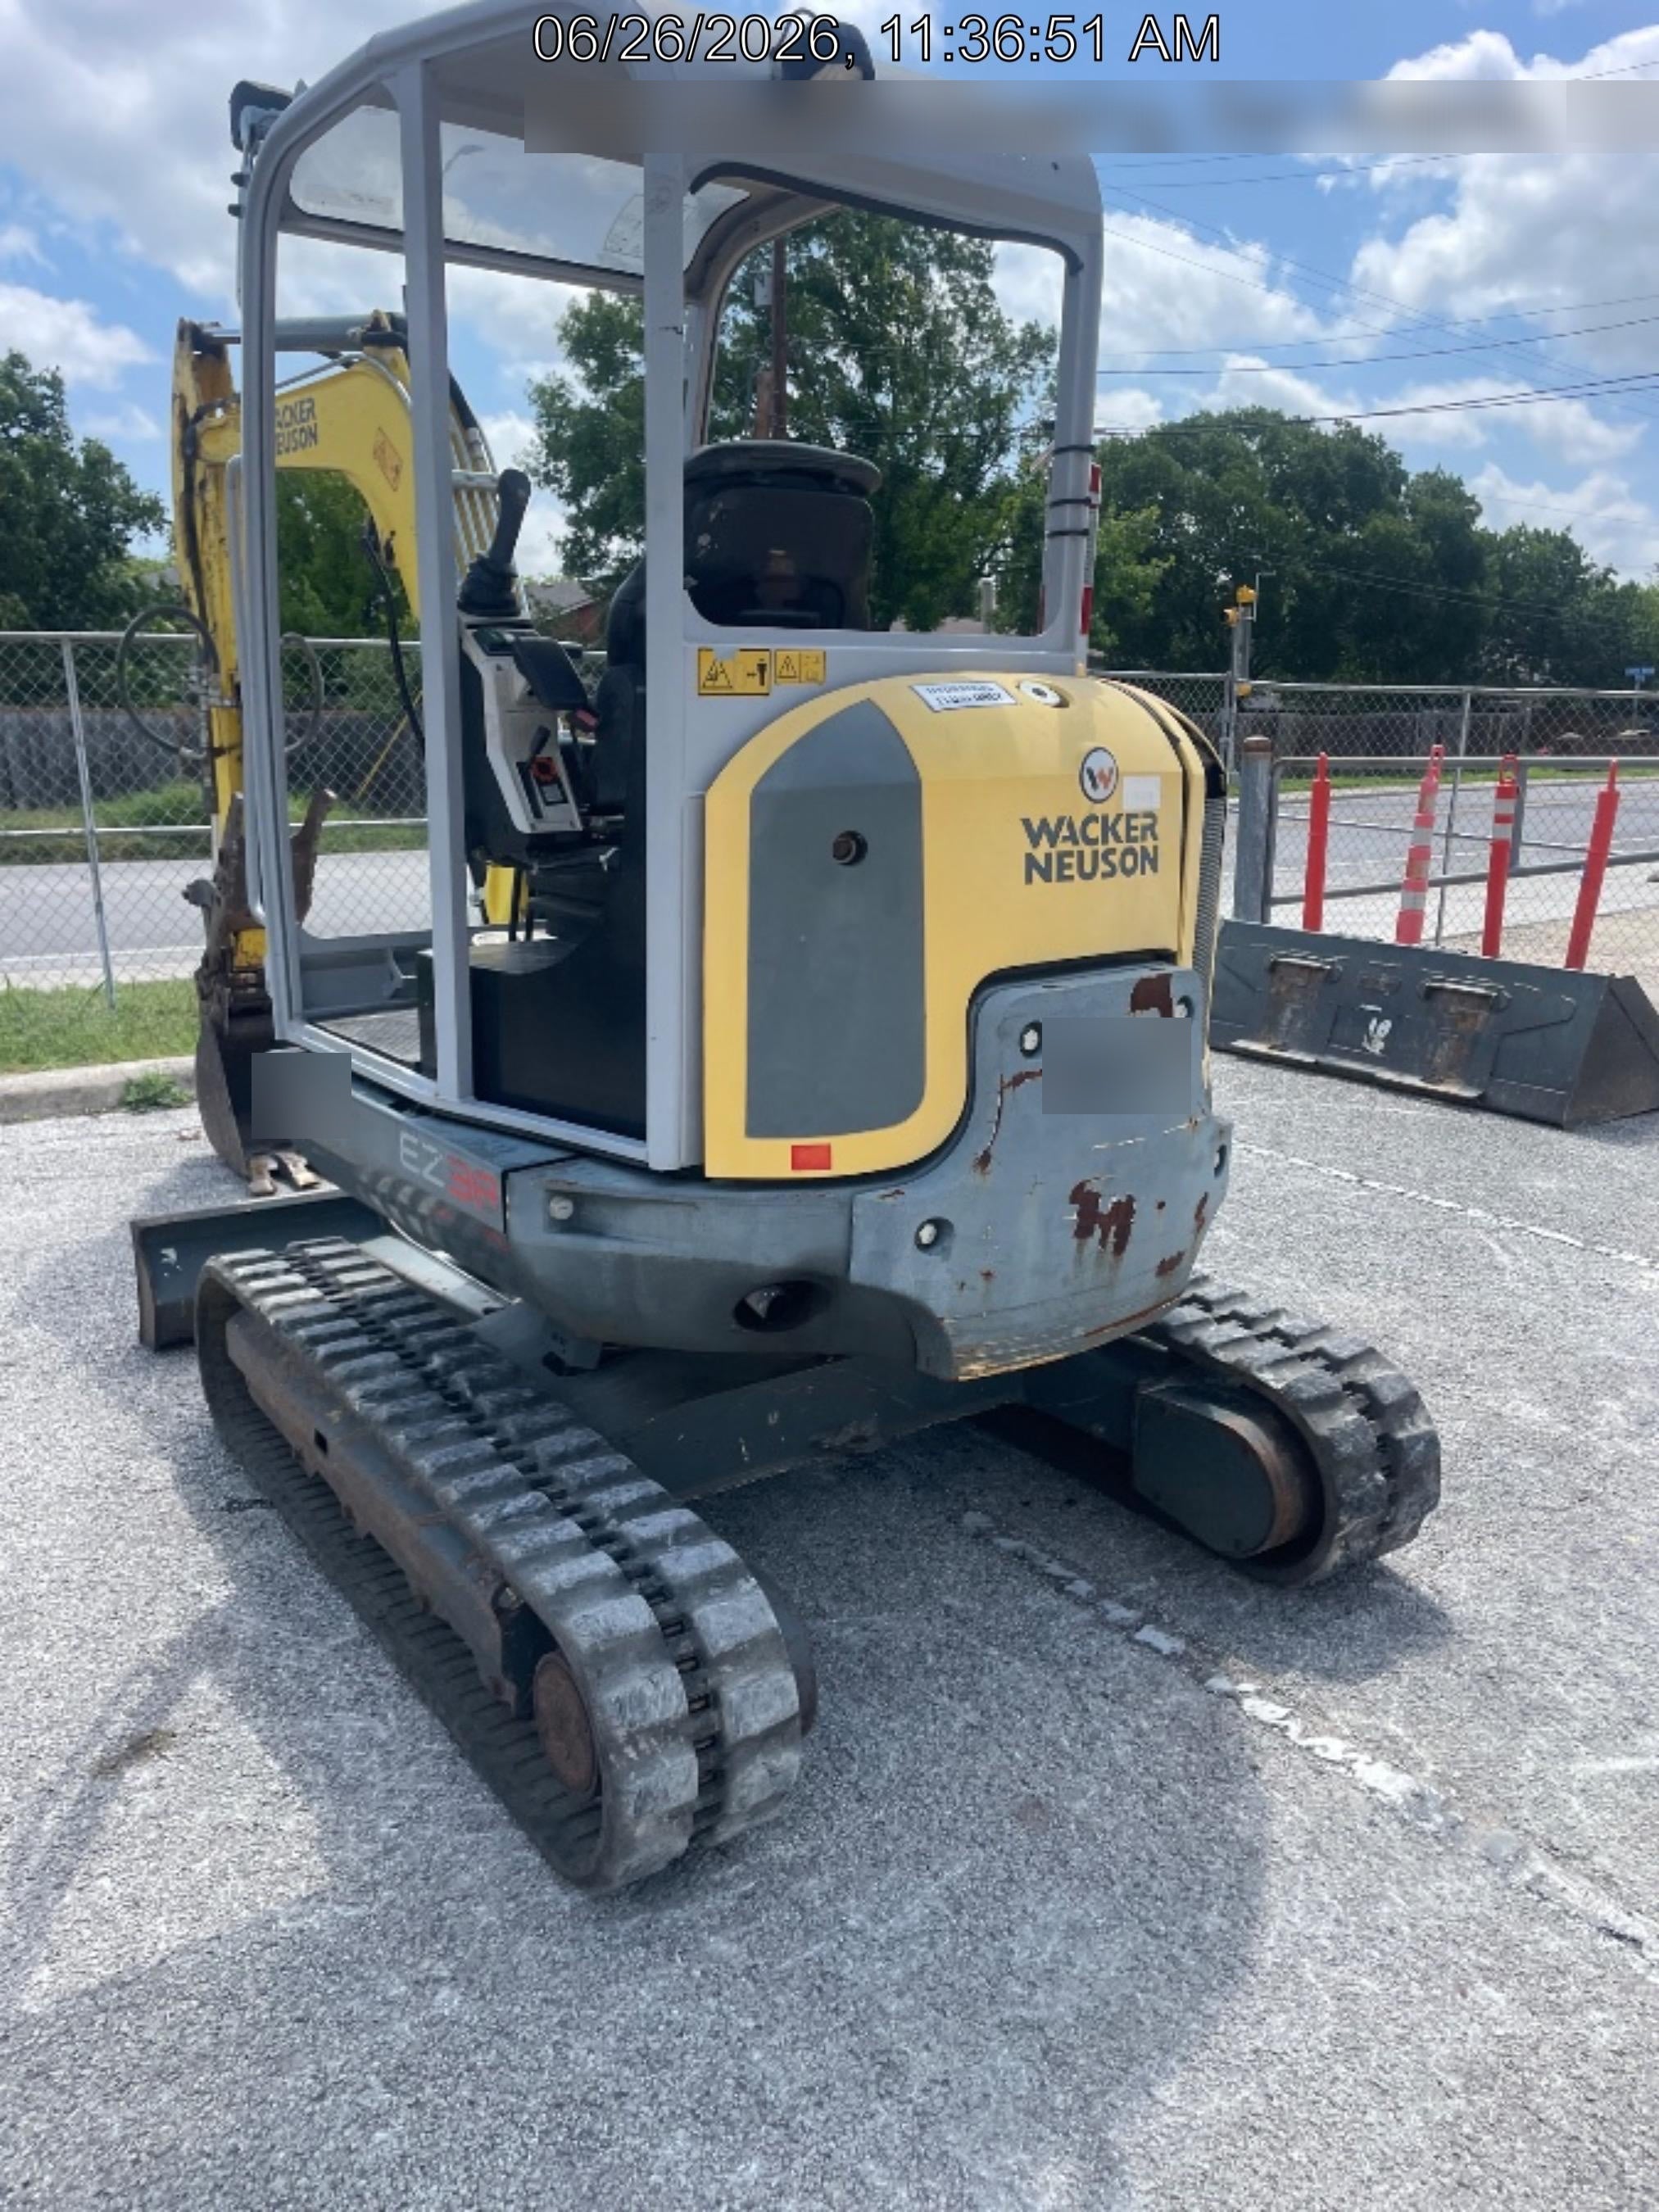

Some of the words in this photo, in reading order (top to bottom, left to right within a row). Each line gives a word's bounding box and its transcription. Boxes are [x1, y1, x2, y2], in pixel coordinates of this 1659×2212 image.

[275, 397, 316, 428] ACKER
[275, 422, 318, 456] EUSON
[1020, 812, 1158, 849] WACKER
[1024, 845, 1158, 885] NEUSON
